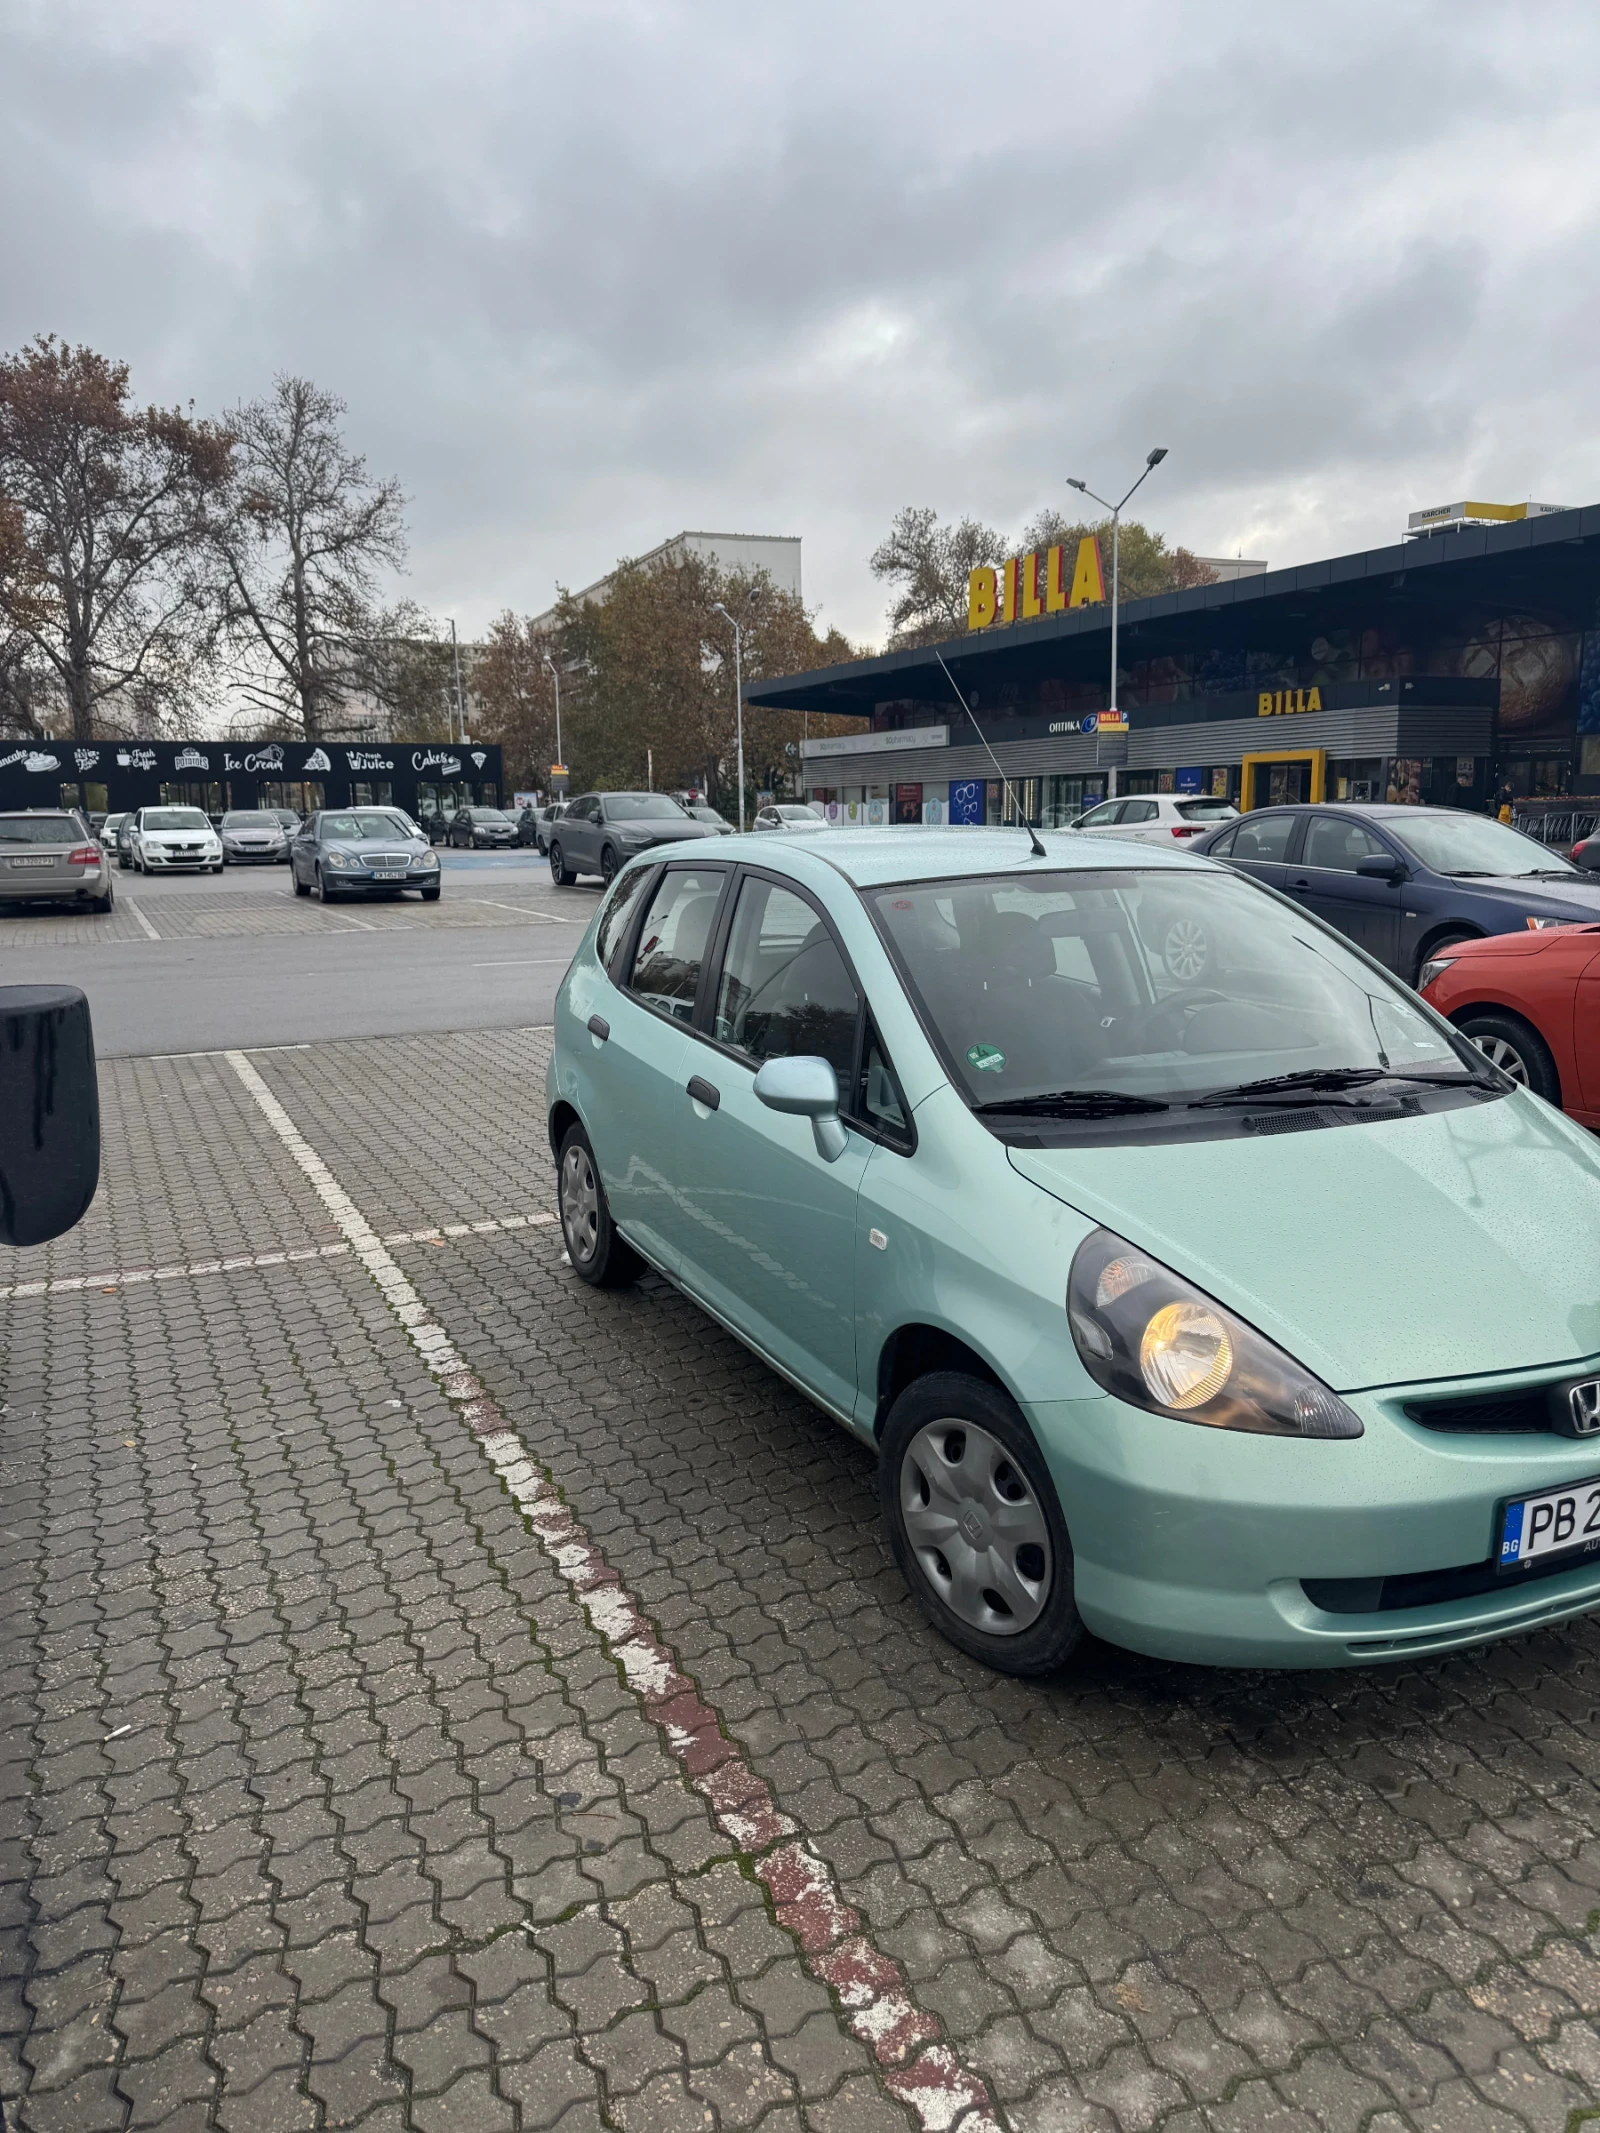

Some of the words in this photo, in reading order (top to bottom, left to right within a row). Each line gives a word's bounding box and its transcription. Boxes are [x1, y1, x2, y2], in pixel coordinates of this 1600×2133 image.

[968, 536, 1105, 630] BILLA
[1258, 686, 1322, 716] BILLA
[1049, 720, 1080, 732] ОПТИКА
[1100, 713, 1120, 723] BILLA
[223, 753, 243, 771] Ice
[244, 753, 283, 773] Cream
[361, 759, 394, 770] Juice
[411, 749, 448, 771] Cakes
[1528, 1496, 1576, 1550] PB
[1582, 1489, 1600, 1535] 2
[1501, 1539, 1519, 1555] BG
